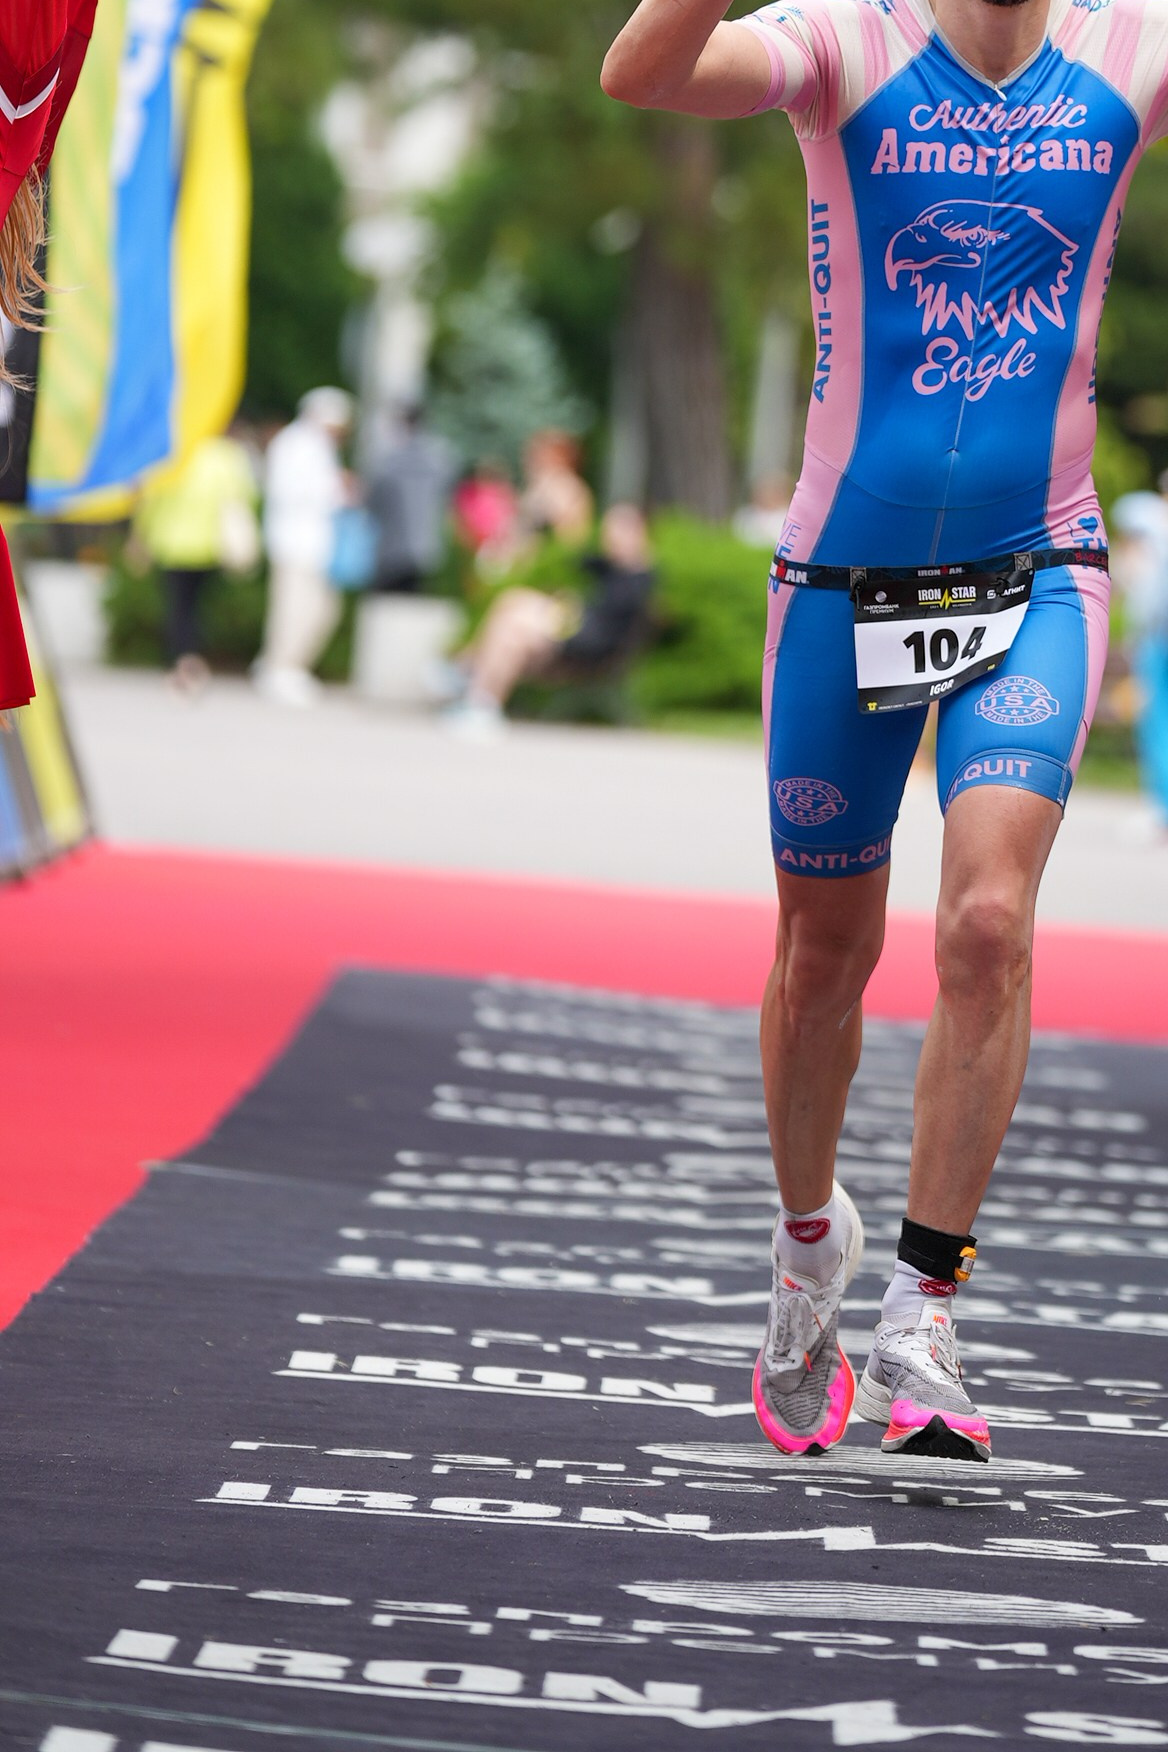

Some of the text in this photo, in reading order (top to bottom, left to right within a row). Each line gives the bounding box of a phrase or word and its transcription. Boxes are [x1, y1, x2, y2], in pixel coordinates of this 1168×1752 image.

[909, 94, 1087, 133] Authentic
[871, 128, 1113, 176] Americana
[811, 199, 832, 403] ANTI-QUIT
[912, 337, 1036, 402] Eagle
[918, 585, 977, 602] IRON STAR
[903, 626, 987, 674] 104
[930, 679, 954, 697] IGOR
[980, 695, 1053, 712] USA
[777, 785, 838, 812] USA
[287, 1350, 717, 1404] IRON
[215, 1481, 712, 1531] IRON
[105, 1628, 702, 1709] IRON
